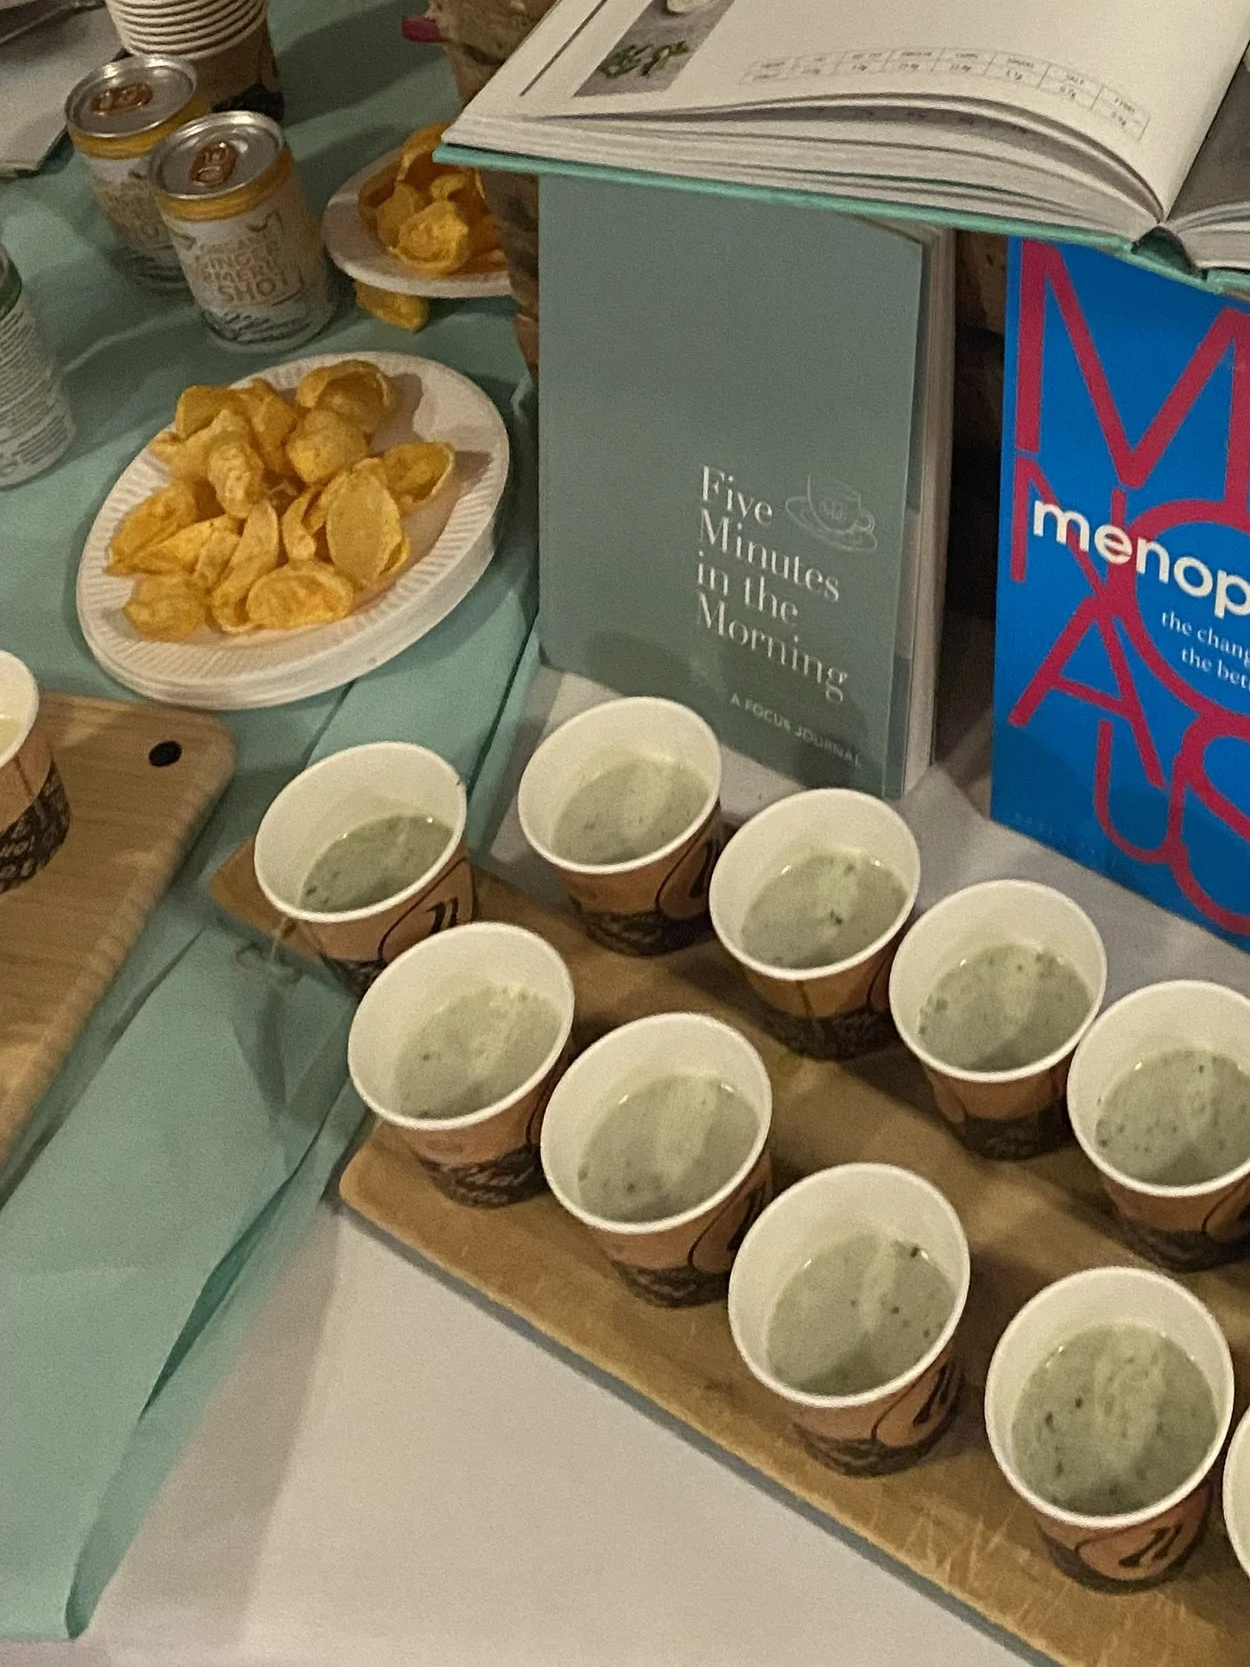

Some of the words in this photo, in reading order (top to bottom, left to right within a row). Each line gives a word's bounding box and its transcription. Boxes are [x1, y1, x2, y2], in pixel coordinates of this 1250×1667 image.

[699, 465, 773, 524] Five
[699, 507, 841, 604] Minutes
[696, 551, 729, 598] in
[741, 573, 799, 626] the
[696, 592, 849, 706] Morning
[1162, 611, 1192, 636] the
[1181, 647, 1212, 672] the
[731, 693, 740, 707] A
